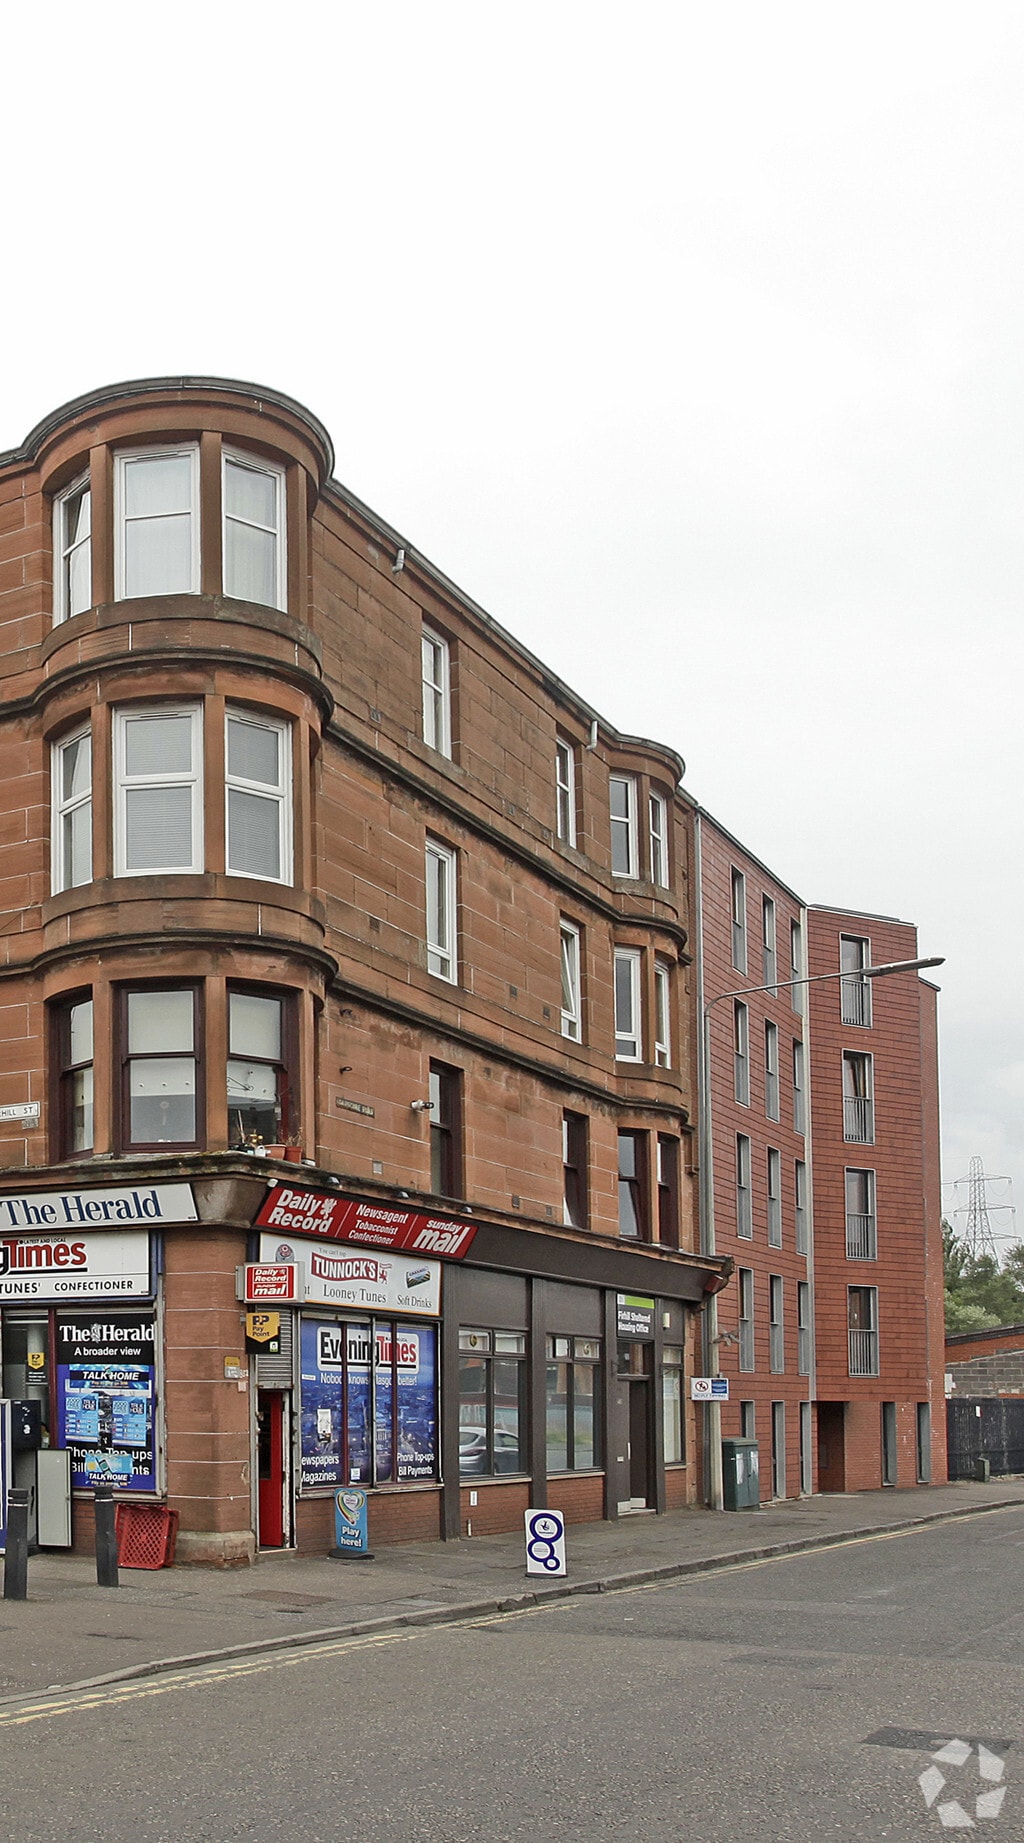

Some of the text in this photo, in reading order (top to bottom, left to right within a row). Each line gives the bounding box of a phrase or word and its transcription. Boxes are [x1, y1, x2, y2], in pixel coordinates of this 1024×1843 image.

[23, 1106, 33, 1114] ST
[0, 1190, 163, 1226] The Herald
[276, 1189, 322, 1215] Daily
[268, 1207, 332, 1233] Record
[356, 1204, 409, 1225] Newsagent
[354, 1219, 399, 1236] Tobacconist
[426, 1219, 462, 1235] sunday
[348, 1230, 394, 1245] Confectioner
[412, 1226, 470, 1254] mail
[313, 1256, 377, 1279] TUNNOCK'S
[54, 1280, 134, 1292] CONFECTIONER
[254, 1285, 285, 1295] mail
[323, 1284, 357, 1303] Looney
[359, 1289, 387, 1304] Tunes
[397, 1294, 432, 1308] Soft Drinks
[59, 1323, 154, 1342] The Herald
[74, 1347, 141, 1356] A broader view
[82, 1371, 140, 1381] TALK HOME
[348, 1374, 369, 1386] knows
[398, 1375, 417, 1386] better!
[301, 1455, 339, 1467] ewspapers
[397, 1452, 414, 1462] Phone
[398, 1466, 433, 1478] Bill Payments
[342, 1526, 360, 1538] Play
[340, 1536, 362, 1547] here!
